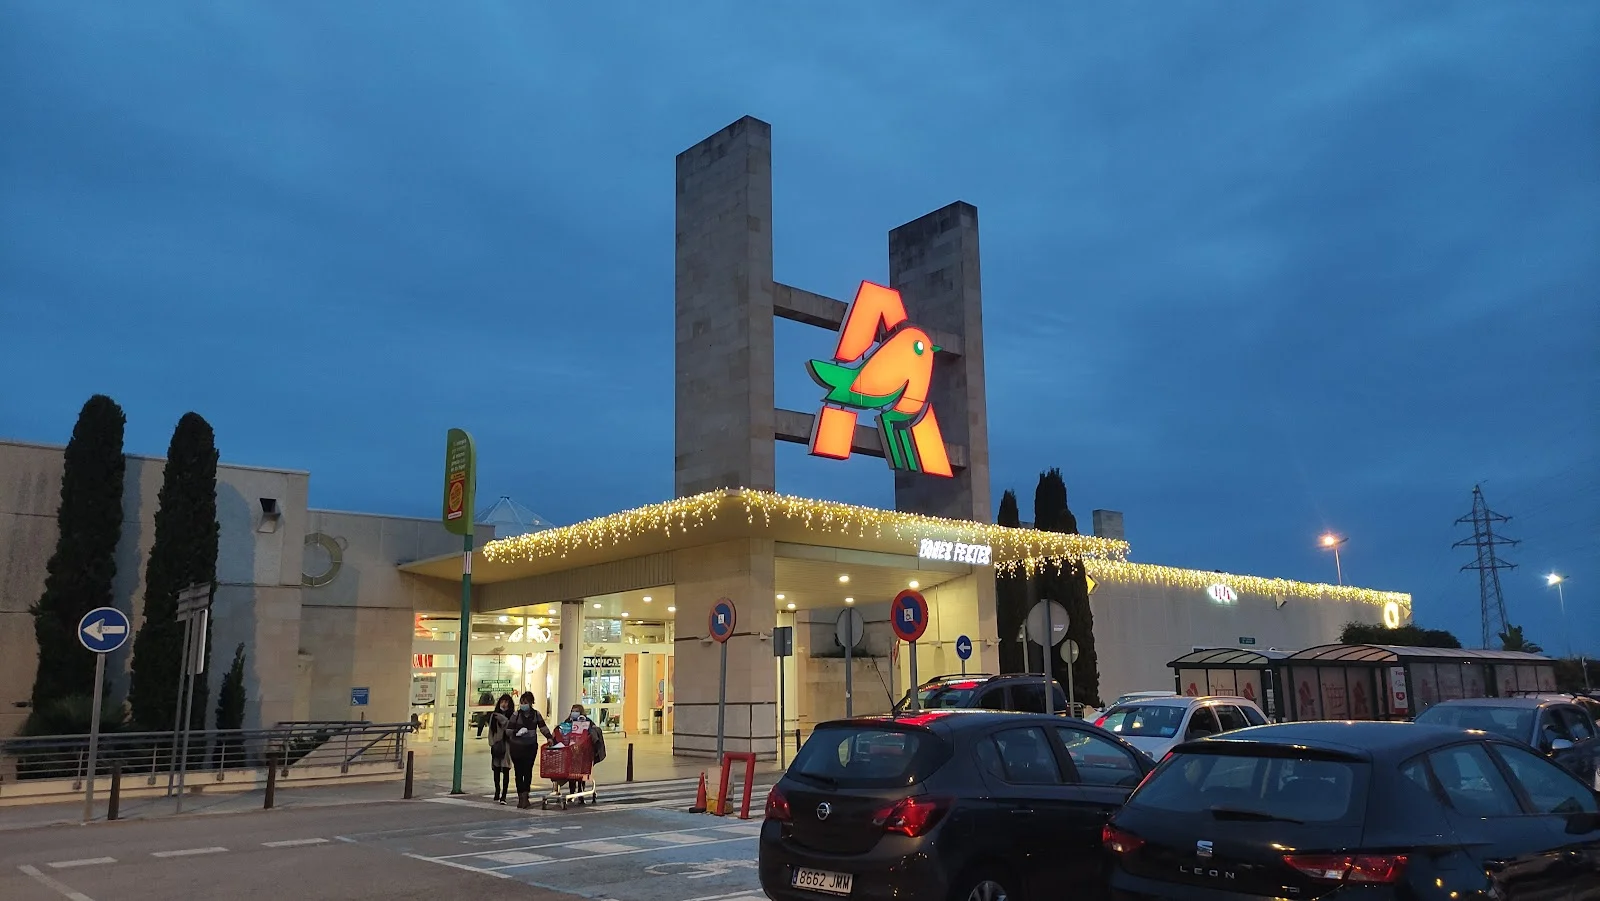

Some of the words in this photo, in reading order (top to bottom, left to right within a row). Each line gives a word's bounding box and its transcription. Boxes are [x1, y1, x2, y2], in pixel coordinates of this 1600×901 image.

[799, 870, 827, 887] 8662
[828, 874, 851, 890] JMM
[1179, 865, 1235, 880] LEON
